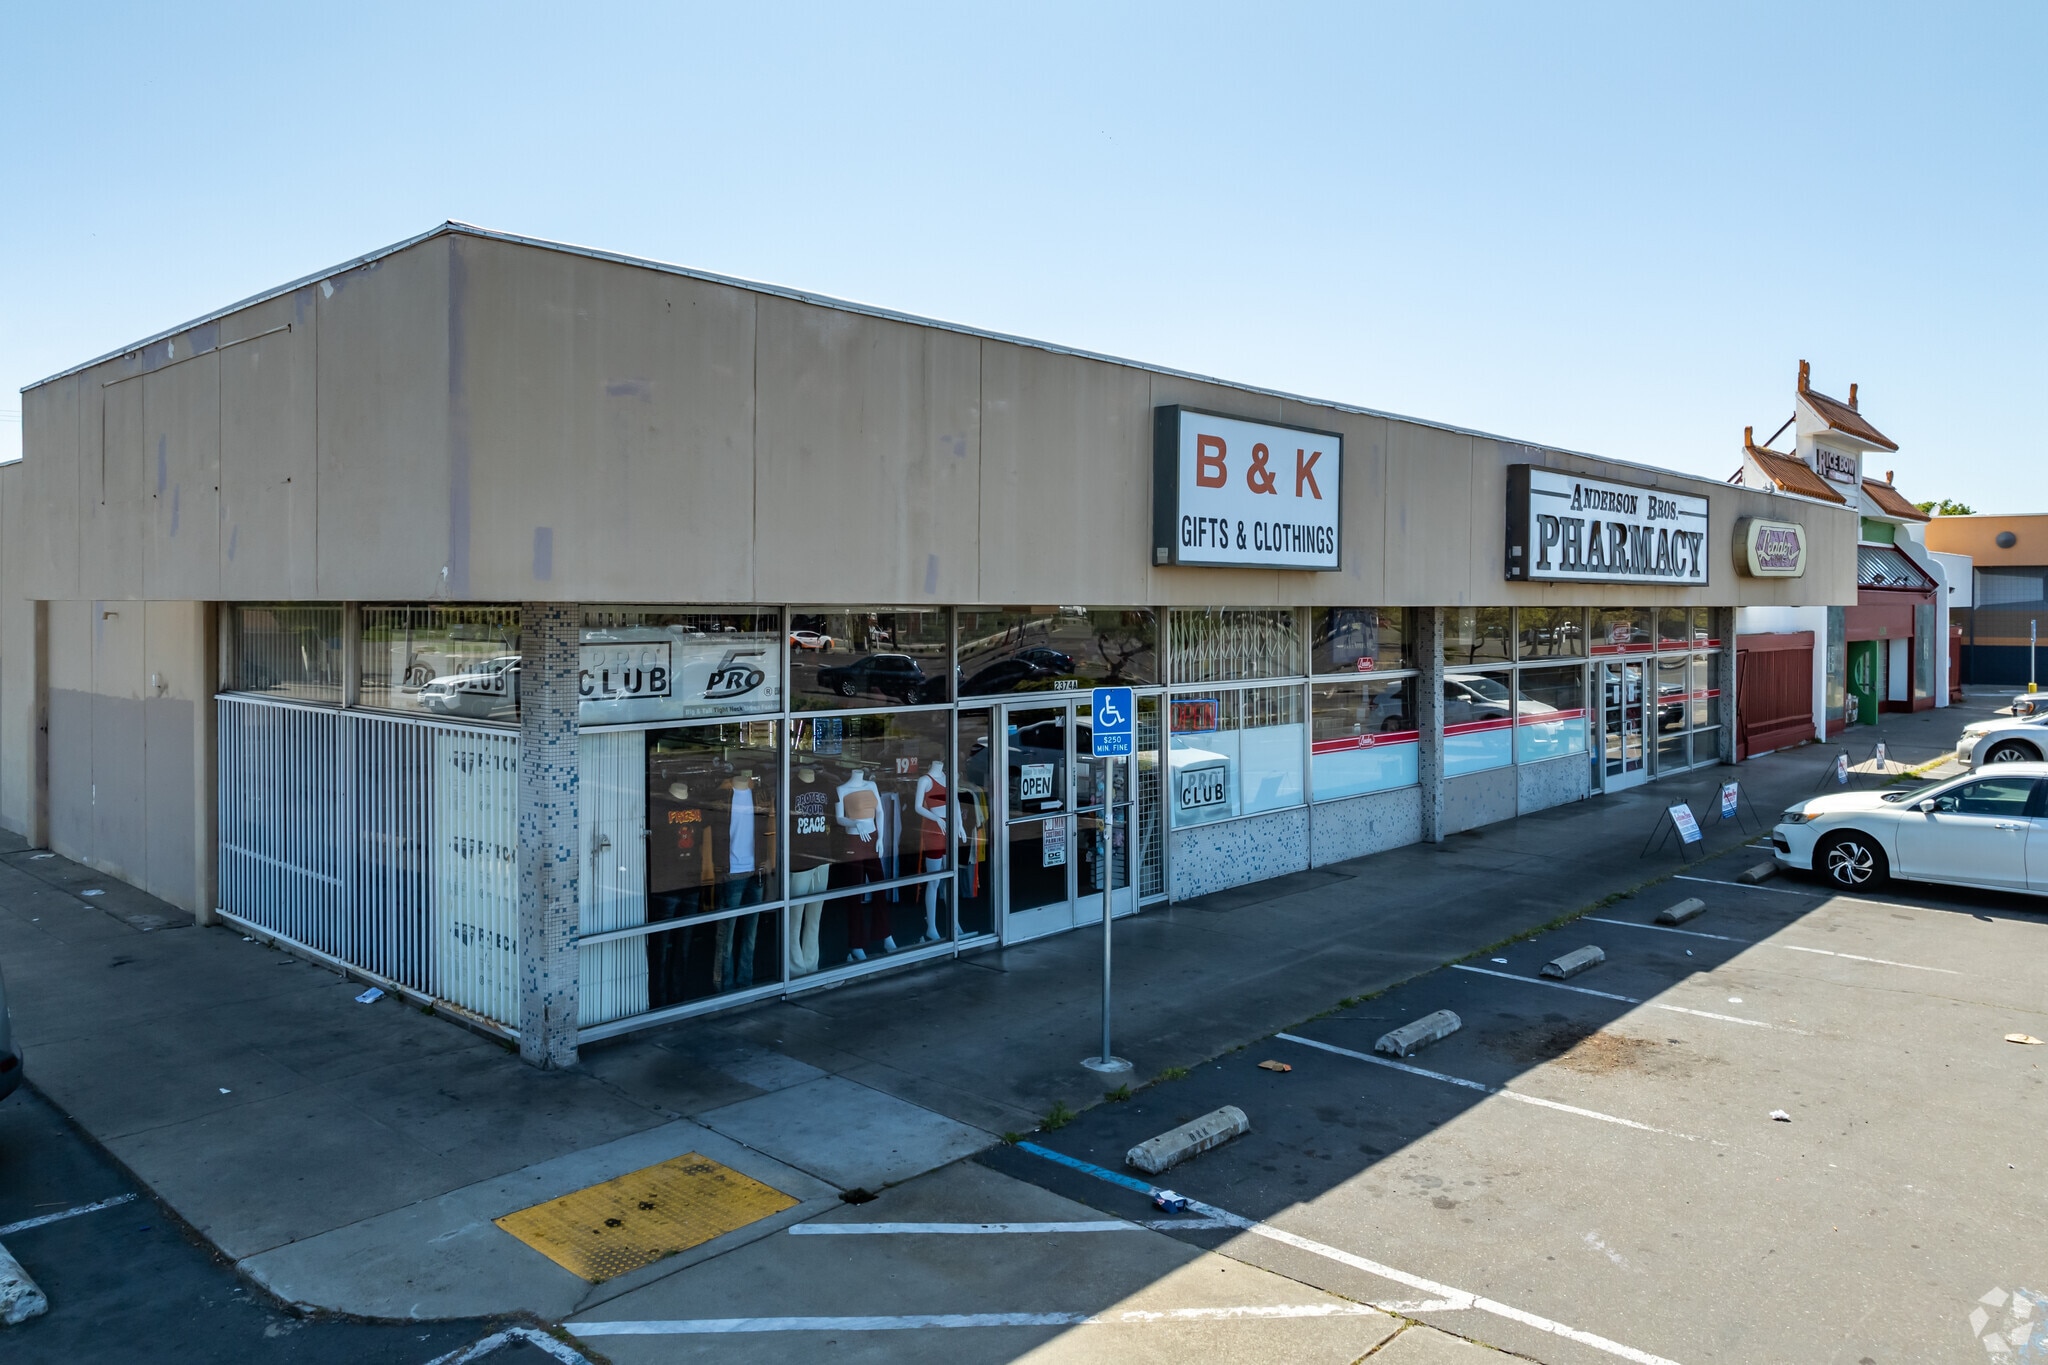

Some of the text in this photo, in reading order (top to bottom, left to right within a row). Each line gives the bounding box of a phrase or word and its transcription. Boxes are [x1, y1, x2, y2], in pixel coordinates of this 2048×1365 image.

[1196, 433, 1323, 500] B & K
[1817, 449, 1839, 476] RICE
[1570, 483, 1639, 515] ANDERSON
[1181, 515, 1334, 555] GIFTS & CLOTHINGS
[1537, 514, 1704, 578] PHARMACY
[1757, 529, 1800, 561] Leader
[593, 650, 658, 675] PRO
[579, 667, 667, 696] CLUB
[706, 670, 766, 691] PRO
[1055, 681, 1077, 690] 2374A
[1170, 703, 1217, 731] OPEN
[1103, 735, 1122, 744] $250
[1113, 743, 1128, 751] FINE
[1022, 776, 1051, 796] OPEN
[1188, 771, 1218, 790] PRO
[1183, 783, 1223, 805] CLUB
[797, 815, 826, 834] PEACE
